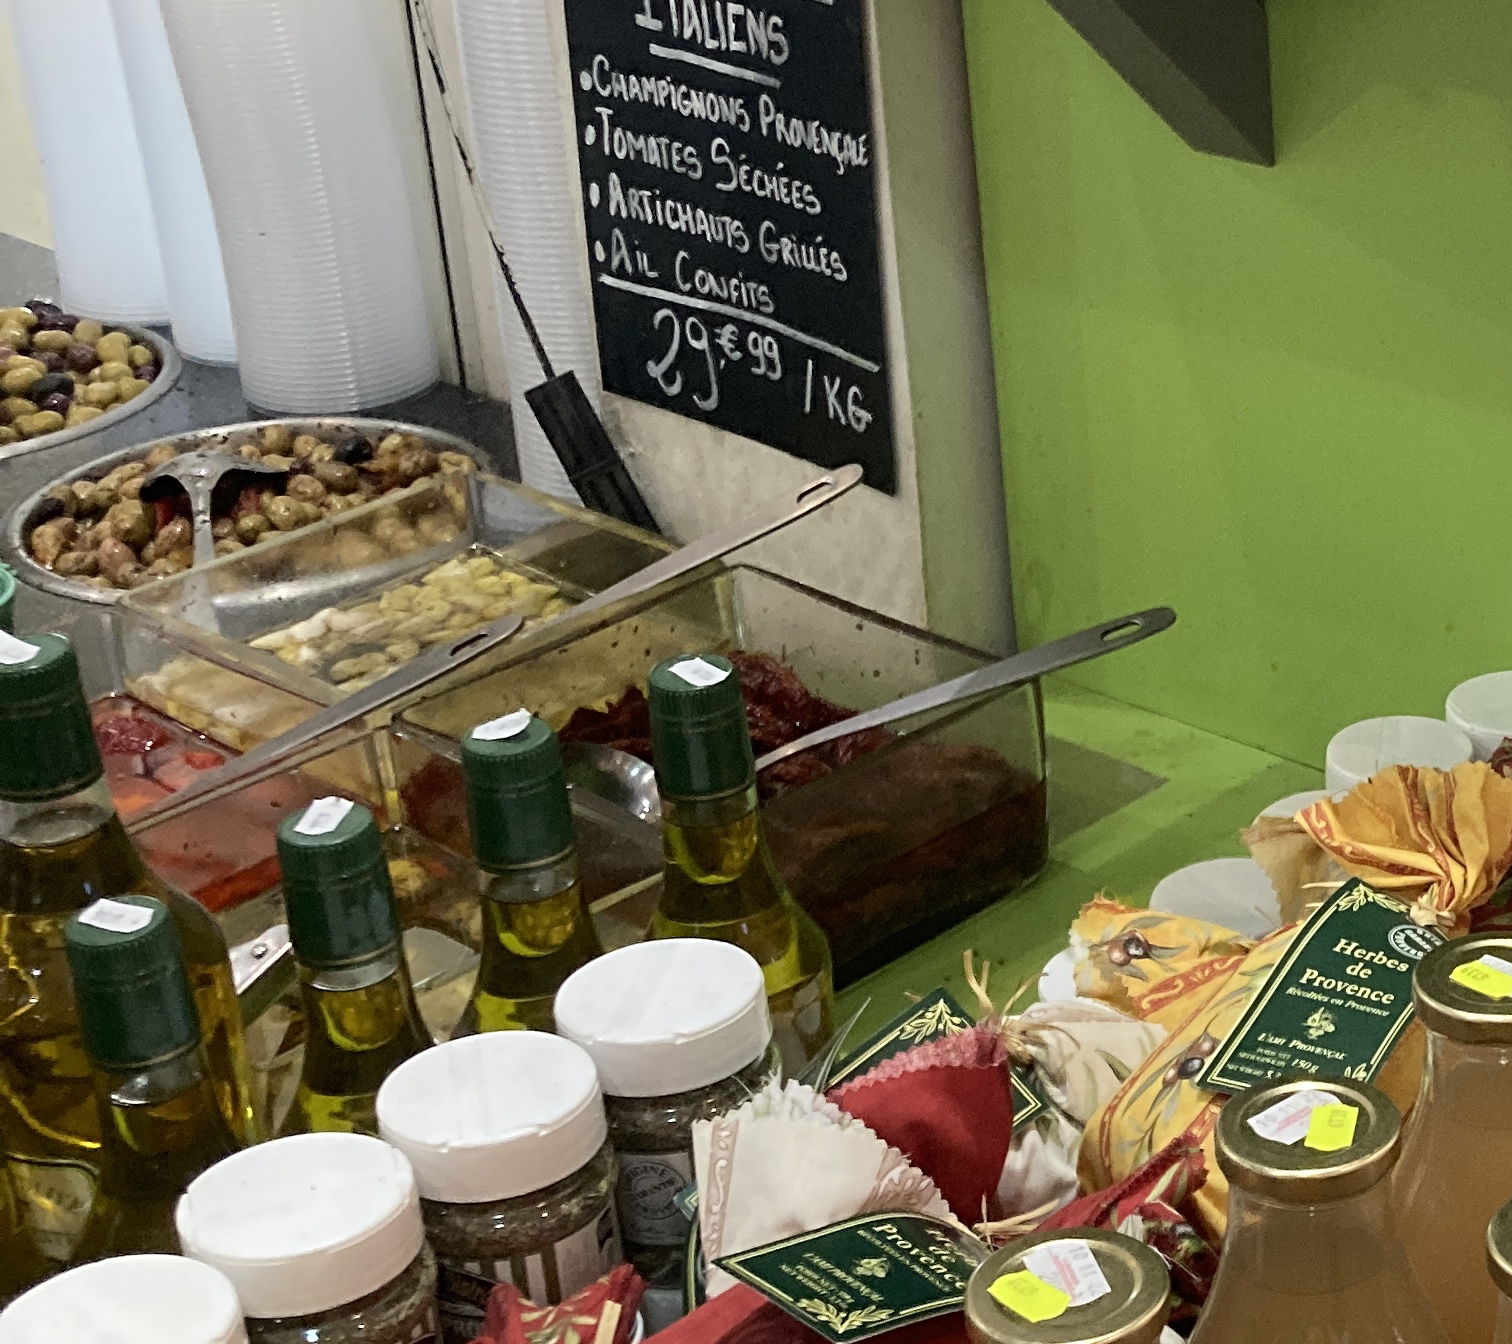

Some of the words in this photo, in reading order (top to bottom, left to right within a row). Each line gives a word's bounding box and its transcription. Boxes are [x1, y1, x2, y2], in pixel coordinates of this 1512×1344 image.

[1331, 937, 1410, 974] Herbes
[1345, 961, 1373, 980] de
[1298, 967, 1396, 1006] Provence
